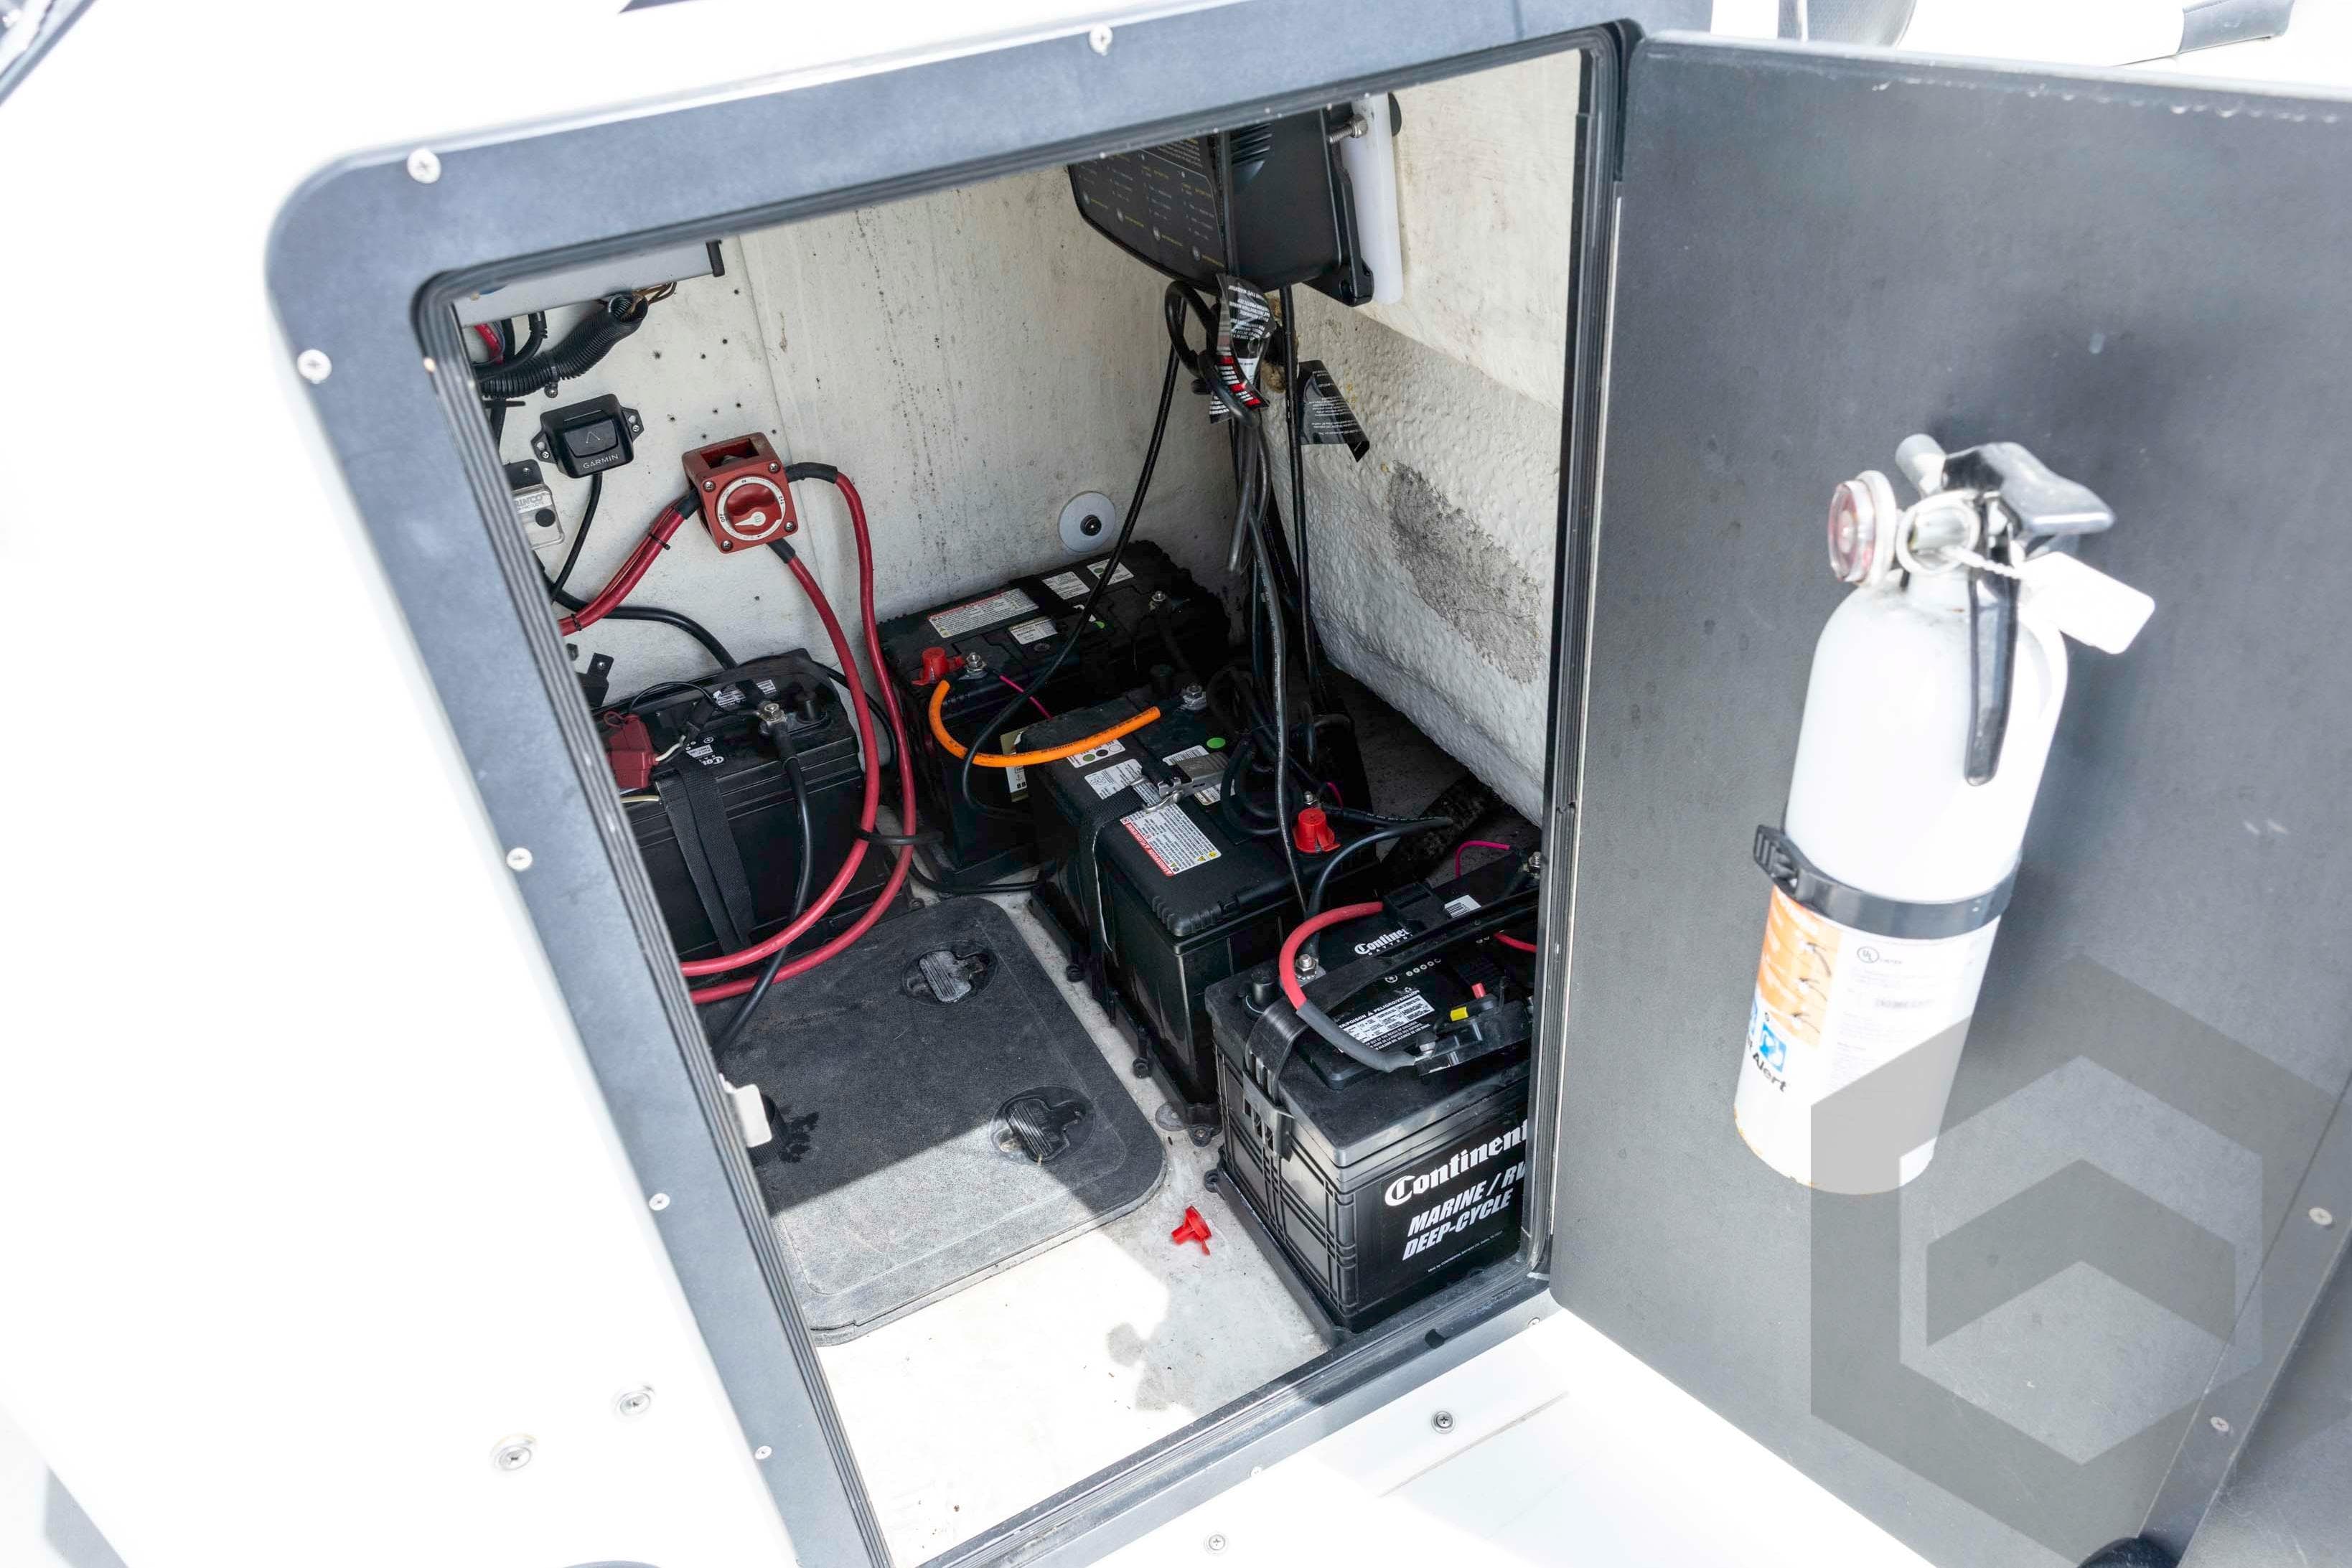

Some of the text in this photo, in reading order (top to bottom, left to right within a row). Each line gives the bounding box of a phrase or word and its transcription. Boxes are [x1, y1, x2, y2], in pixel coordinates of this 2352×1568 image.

[583, 454, 619, 469] GARMIN
[1753, 1052, 1786, 1092] Alert
[1402, 1188, 1514, 1261] DEEP-CYCLE
[1407, 1161, 1527, 1237] MARINE / RV
